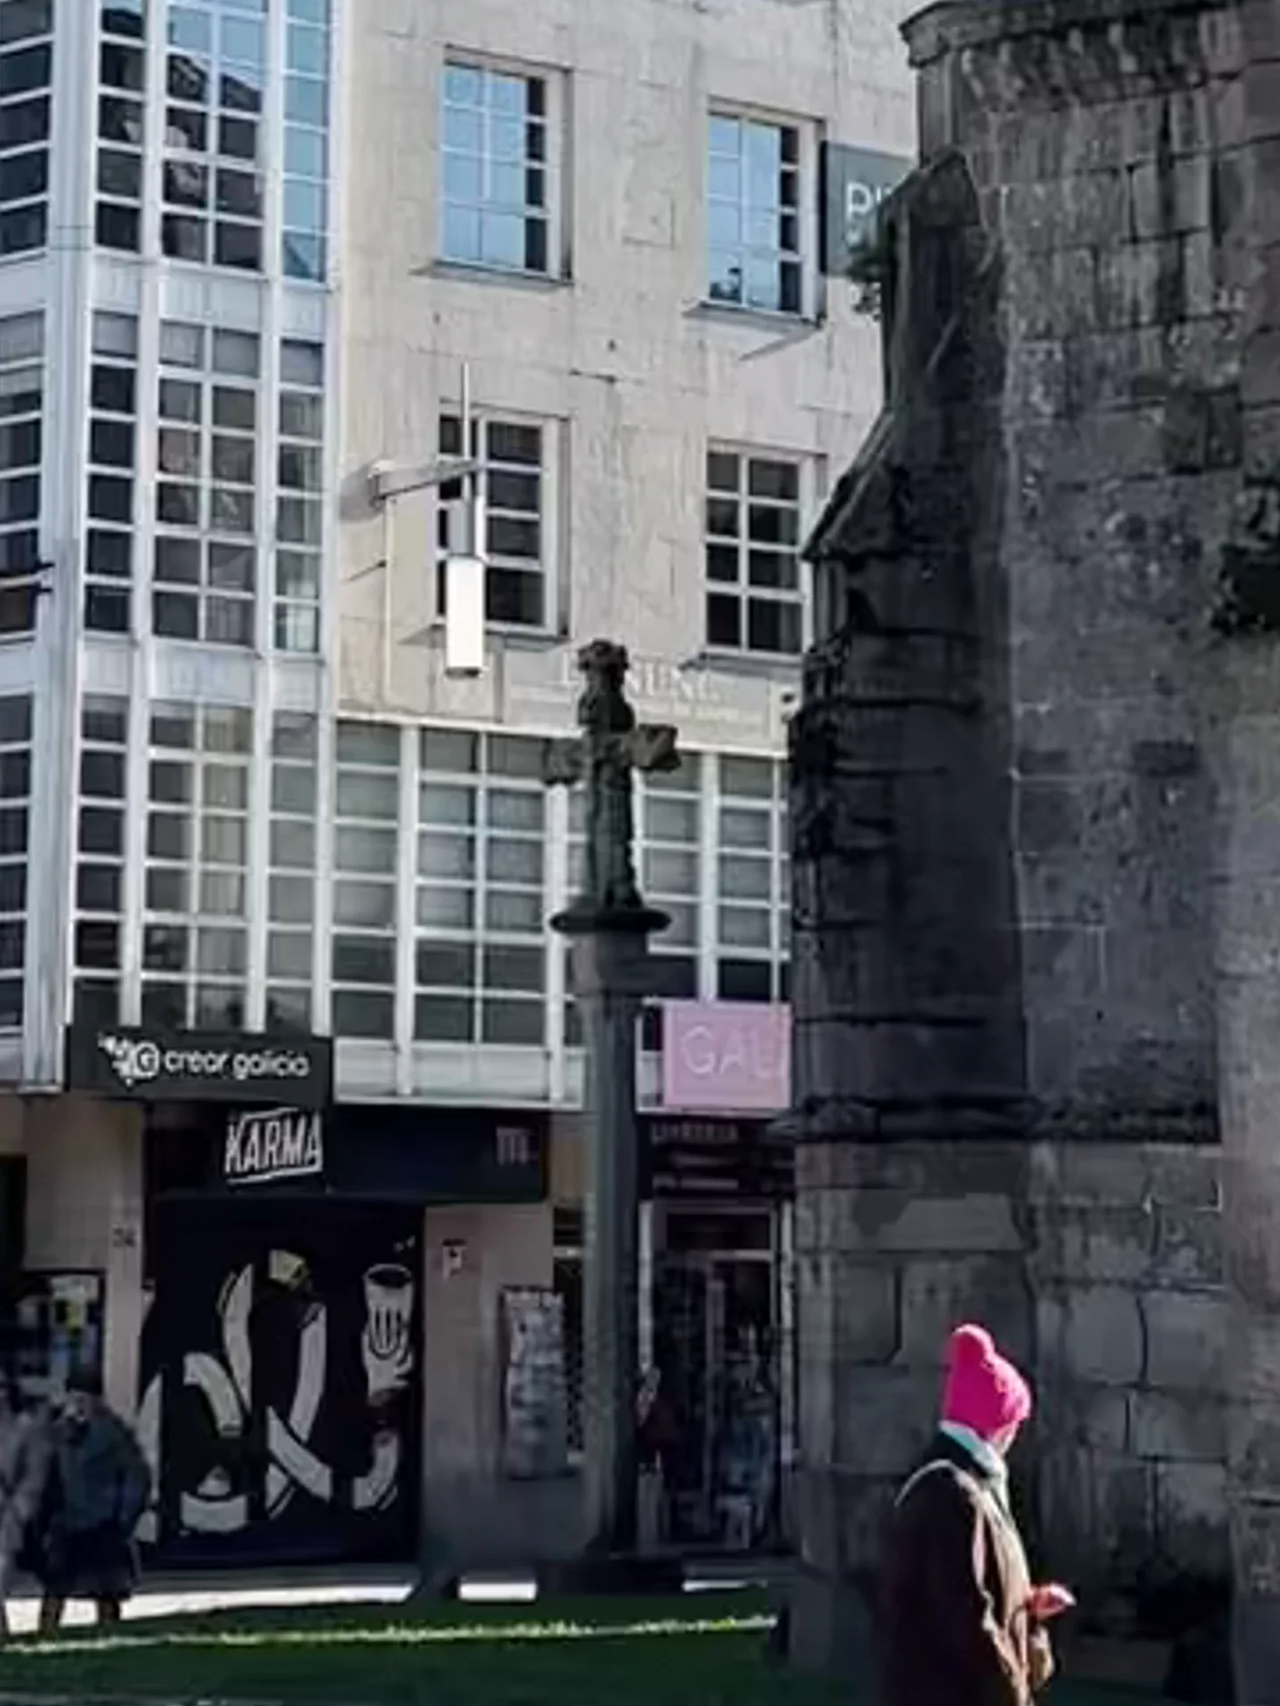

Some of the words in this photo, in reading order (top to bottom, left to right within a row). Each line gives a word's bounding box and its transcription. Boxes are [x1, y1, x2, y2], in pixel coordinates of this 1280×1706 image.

[164, 1050, 230, 1073] crear
[232, 1049, 311, 1080] galicia
[225, 1110, 324, 1174] KARMA
